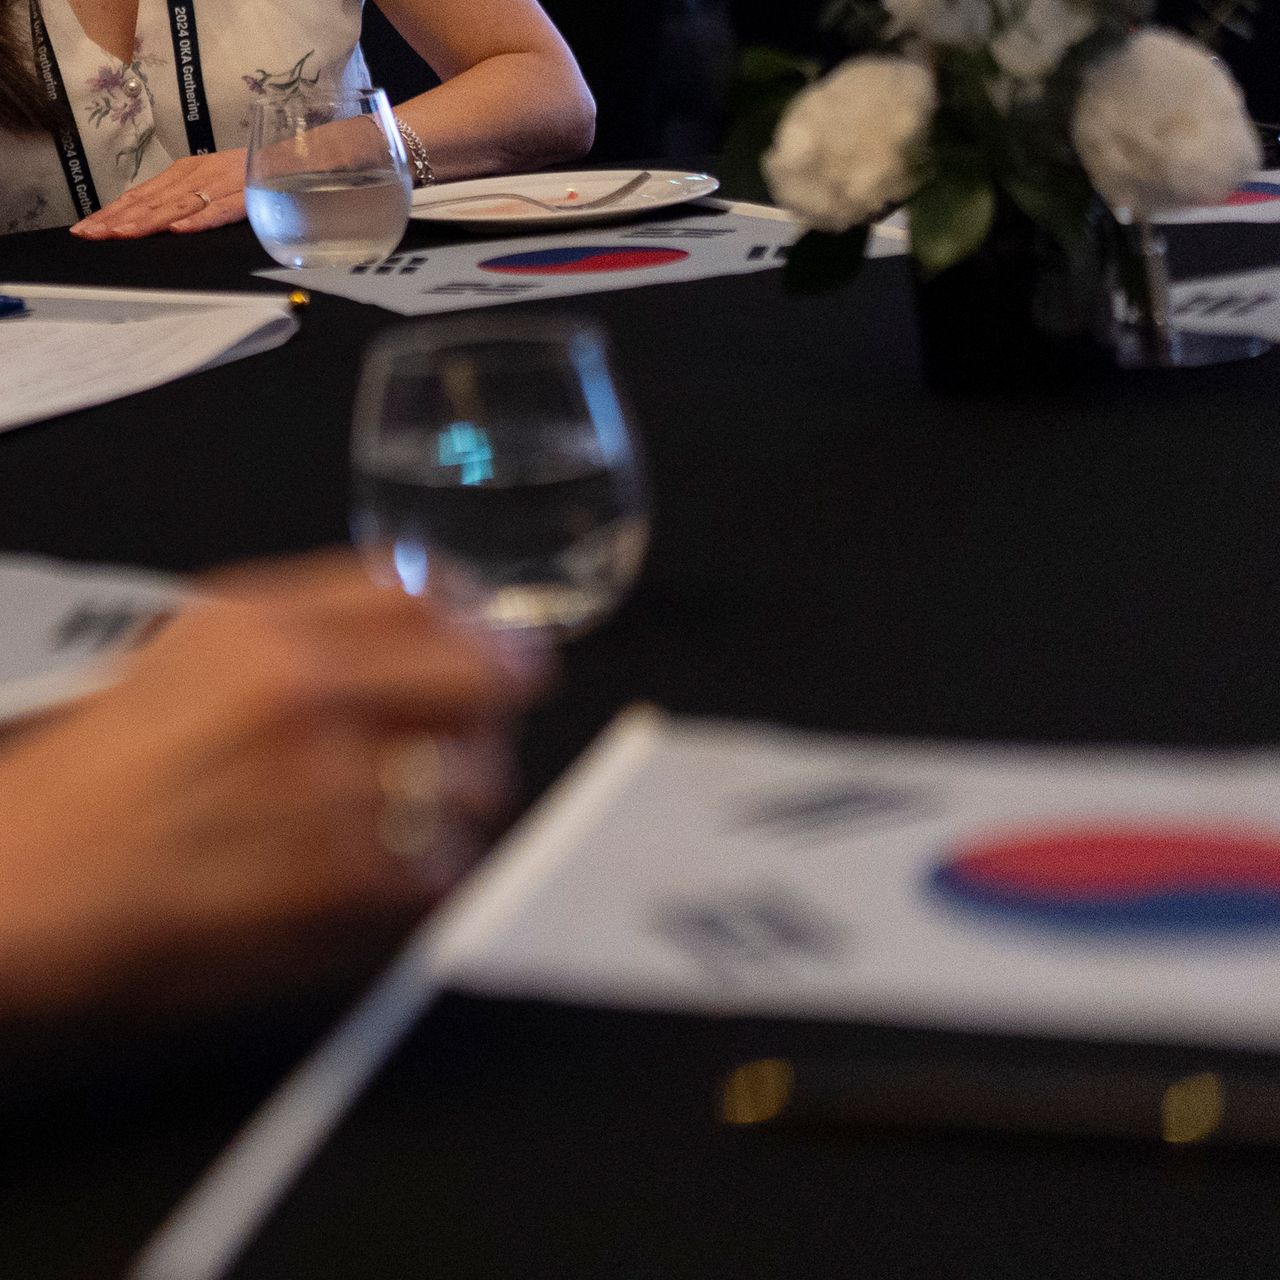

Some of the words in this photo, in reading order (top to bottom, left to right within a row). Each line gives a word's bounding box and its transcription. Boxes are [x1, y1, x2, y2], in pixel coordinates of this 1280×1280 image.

[175, 6, 189, 38] 2024
[179, 39, 192, 65] OKA
[183, 65, 200, 122] Gathering
[68, 159, 84, 183] OKA
[76, 184, 93, 216] Gathe
